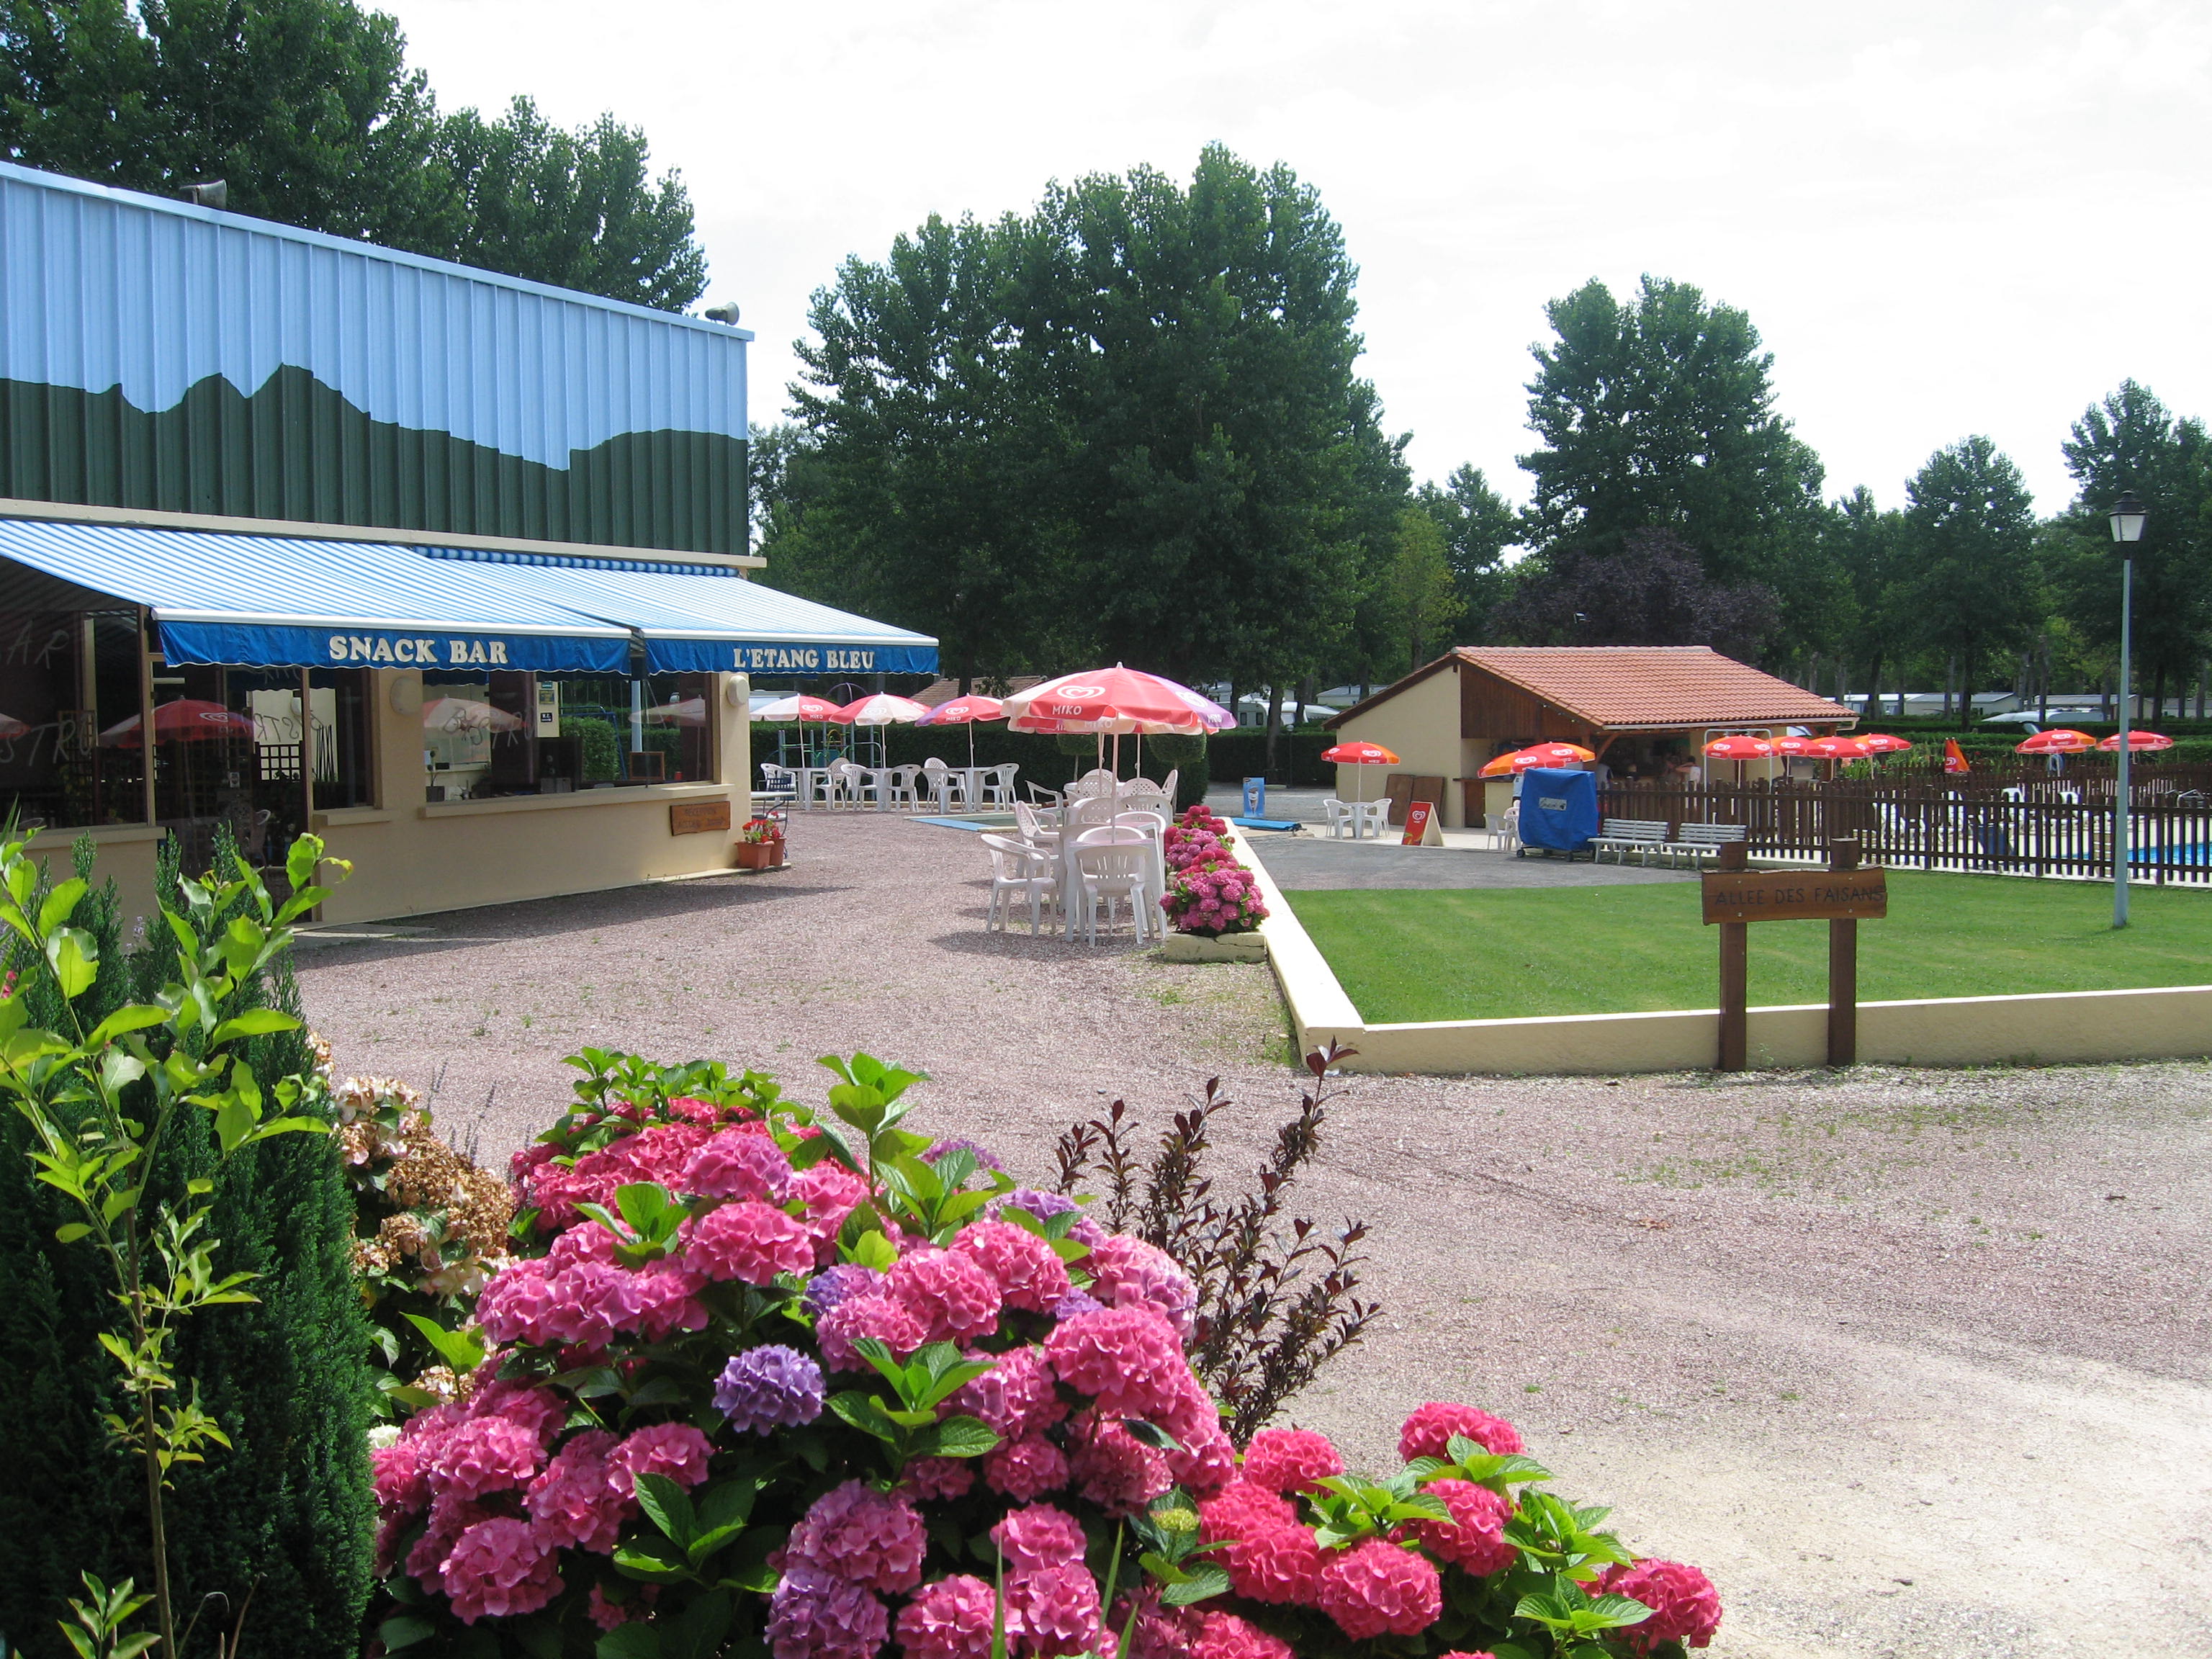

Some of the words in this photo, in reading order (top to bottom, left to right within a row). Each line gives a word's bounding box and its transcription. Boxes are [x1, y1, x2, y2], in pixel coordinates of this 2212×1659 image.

[329, 635, 438, 662] SNACK
[449, 639, 508, 664] BAR
[733, 648, 819, 668] L'ETANG
[826, 649, 875, 669] BLEU
[1052, 704, 1082, 715] MIKO
[1714, 889, 1766, 905] ALLEE
[1775, 888, 1805, 904] DES
[1814, 885, 1885, 902] FAISANS
